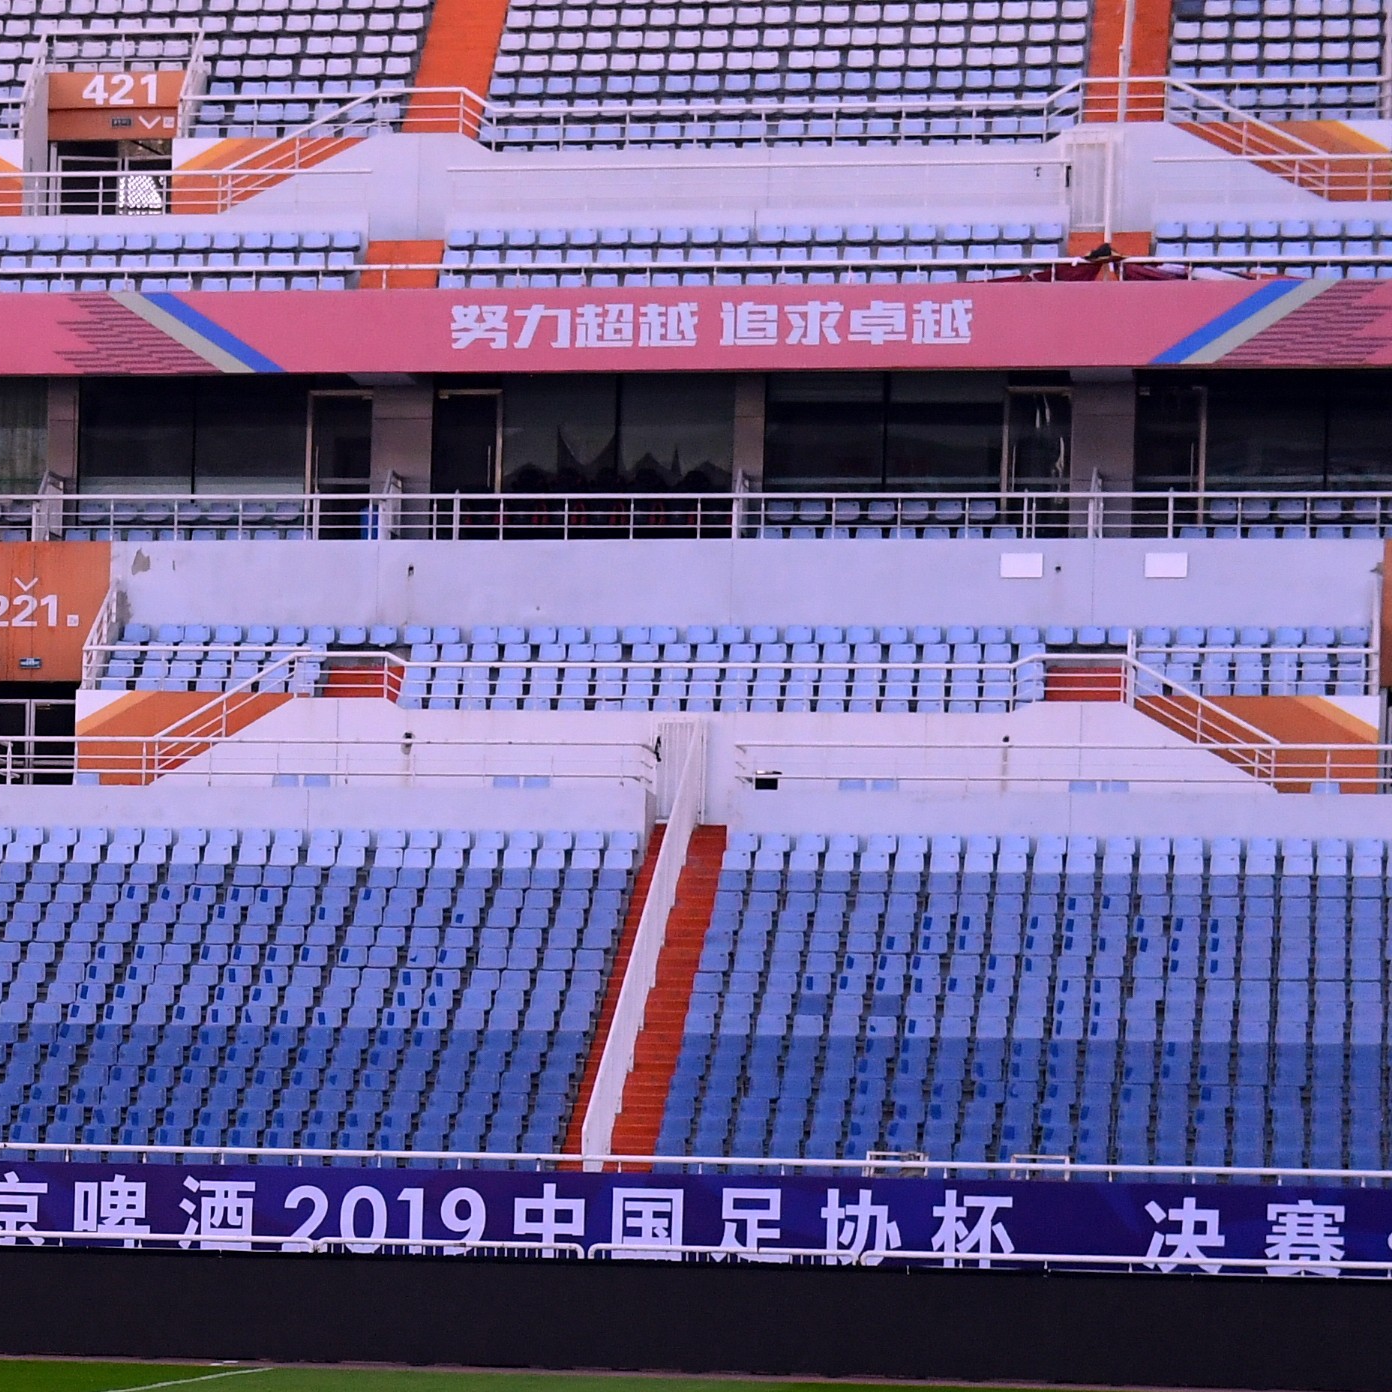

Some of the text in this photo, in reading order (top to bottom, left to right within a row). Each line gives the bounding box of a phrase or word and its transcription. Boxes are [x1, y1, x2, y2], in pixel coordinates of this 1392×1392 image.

[82, 74, 158, 105] 421
[451, 298, 973, 350] 努力超越 追求卓越
[1143, 1197, 1346, 1277] 决赛
